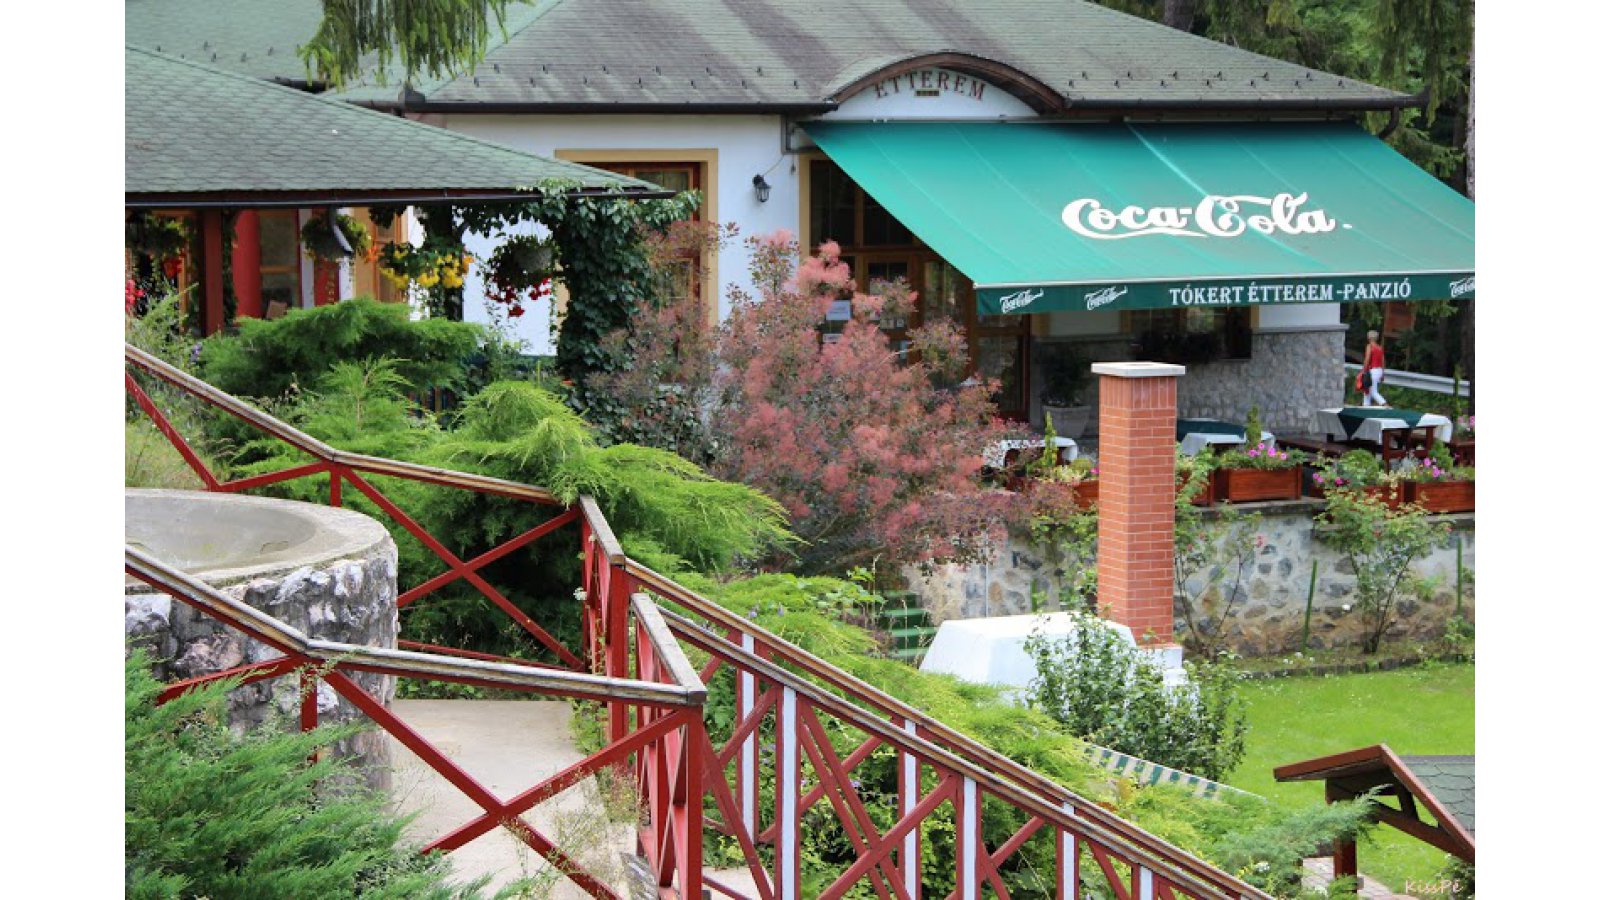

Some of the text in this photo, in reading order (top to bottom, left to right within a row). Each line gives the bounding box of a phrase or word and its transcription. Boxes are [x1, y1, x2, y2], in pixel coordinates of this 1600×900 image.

[1061, 192, 1336, 239] Coca-Cola
[1169, 283, 1244, 305] TÓKERT
[1248, 281, 1333, 302] ÉTTEREM
